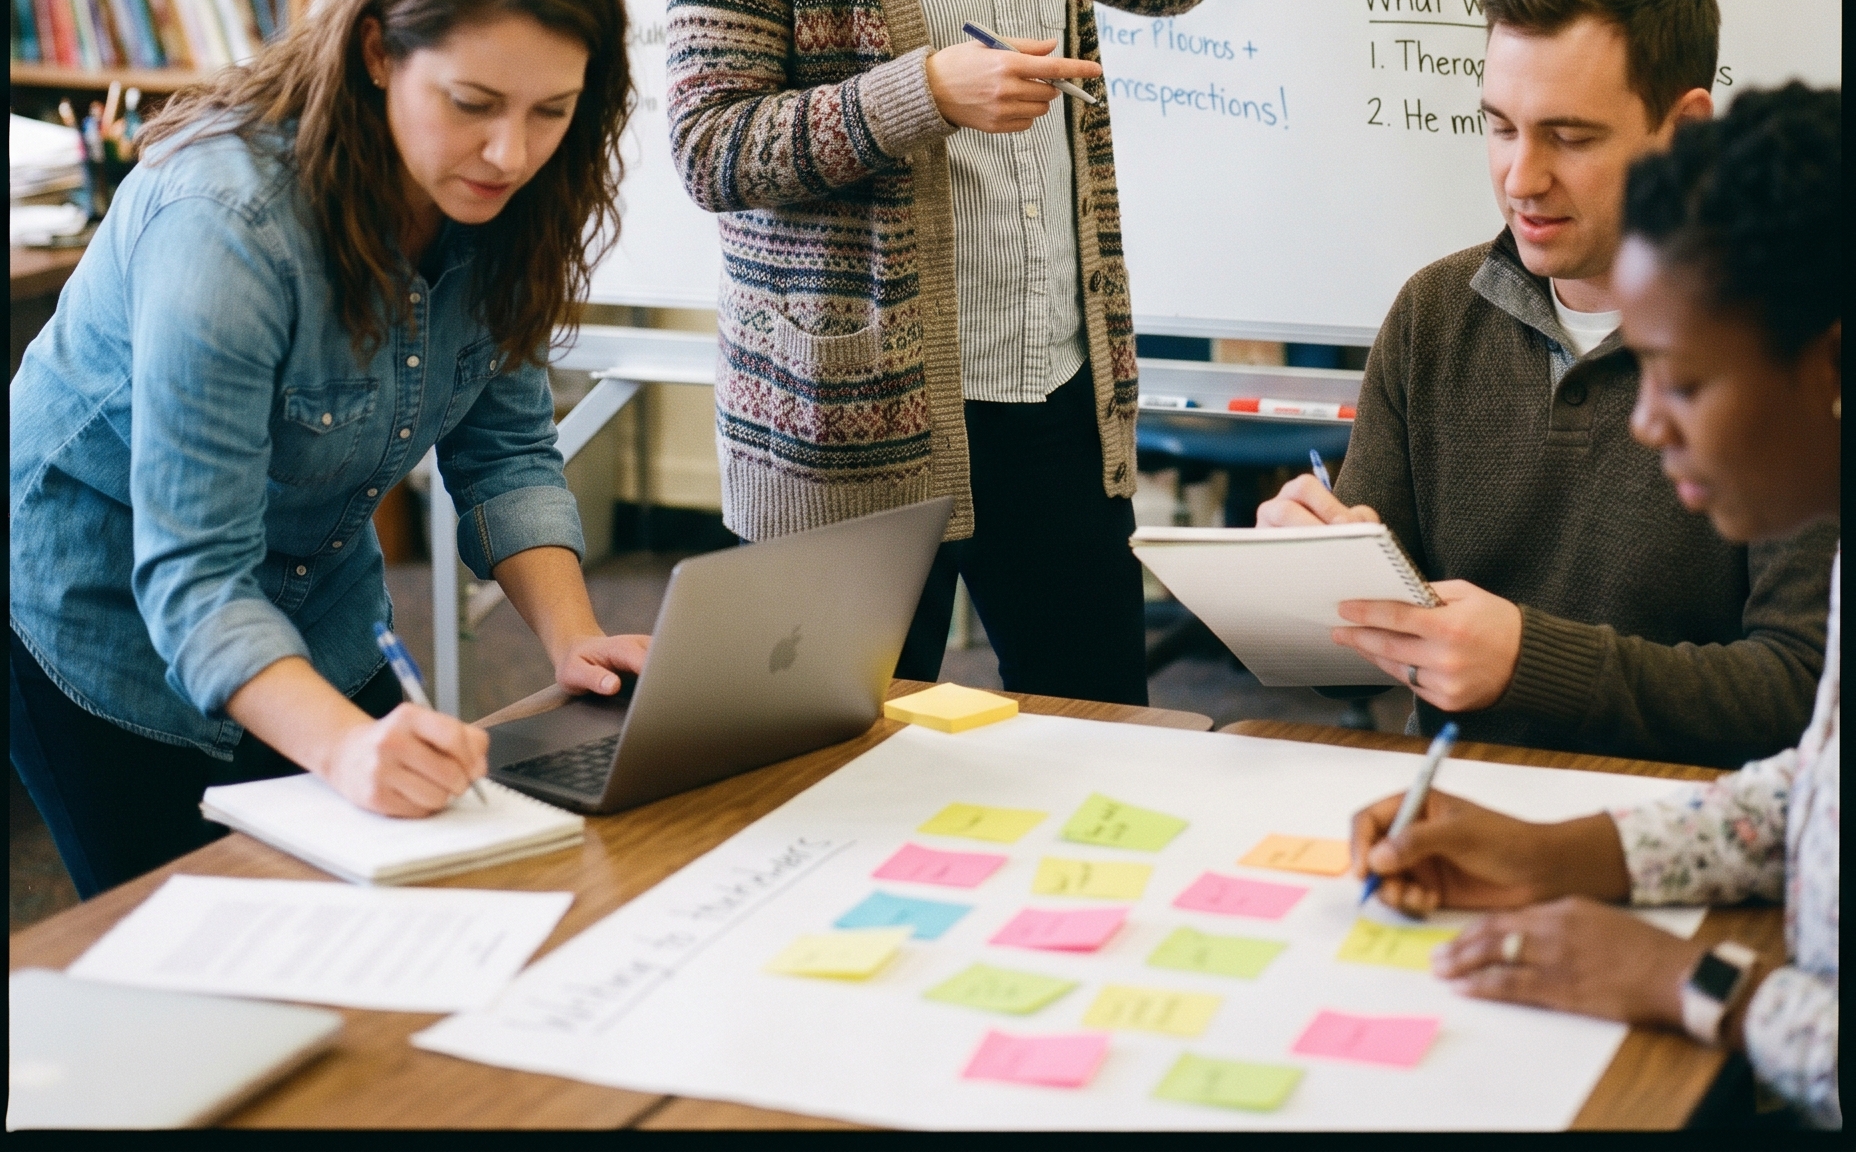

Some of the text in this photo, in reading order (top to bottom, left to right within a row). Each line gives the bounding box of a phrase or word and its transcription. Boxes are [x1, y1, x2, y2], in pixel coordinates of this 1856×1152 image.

[1371, 41, 1384, 69] 1.
[1367, 97, 1390, 126] 2.
[1404, 99, 1439, 133] He
